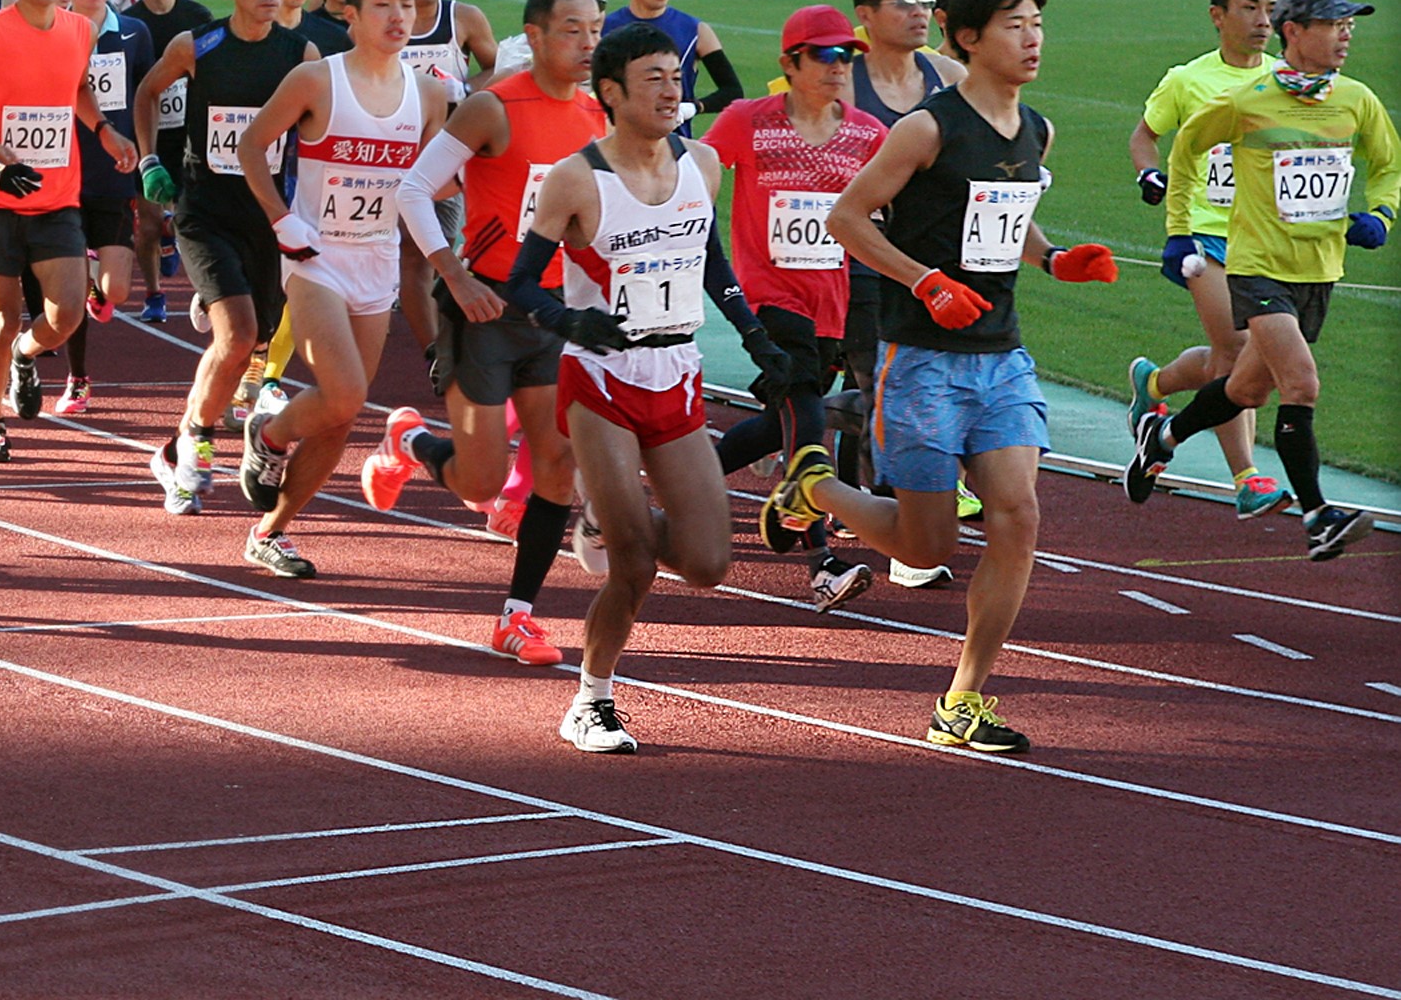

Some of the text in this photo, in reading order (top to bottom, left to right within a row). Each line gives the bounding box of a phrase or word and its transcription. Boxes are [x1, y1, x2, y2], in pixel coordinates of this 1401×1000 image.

[160, 96, 184, 115] 60
[3, 127, 67, 149] A2021
[331, 140, 414, 165] 愛知大学
[1207, 162, 1235, 187] A2
[1279, 172, 1350, 201] A2071
[323, 194, 384, 221] A 24
[771, 217, 839, 245] A602
[967, 212, 1025, 244] A 16
[615, 280, 671, 314] A 1
